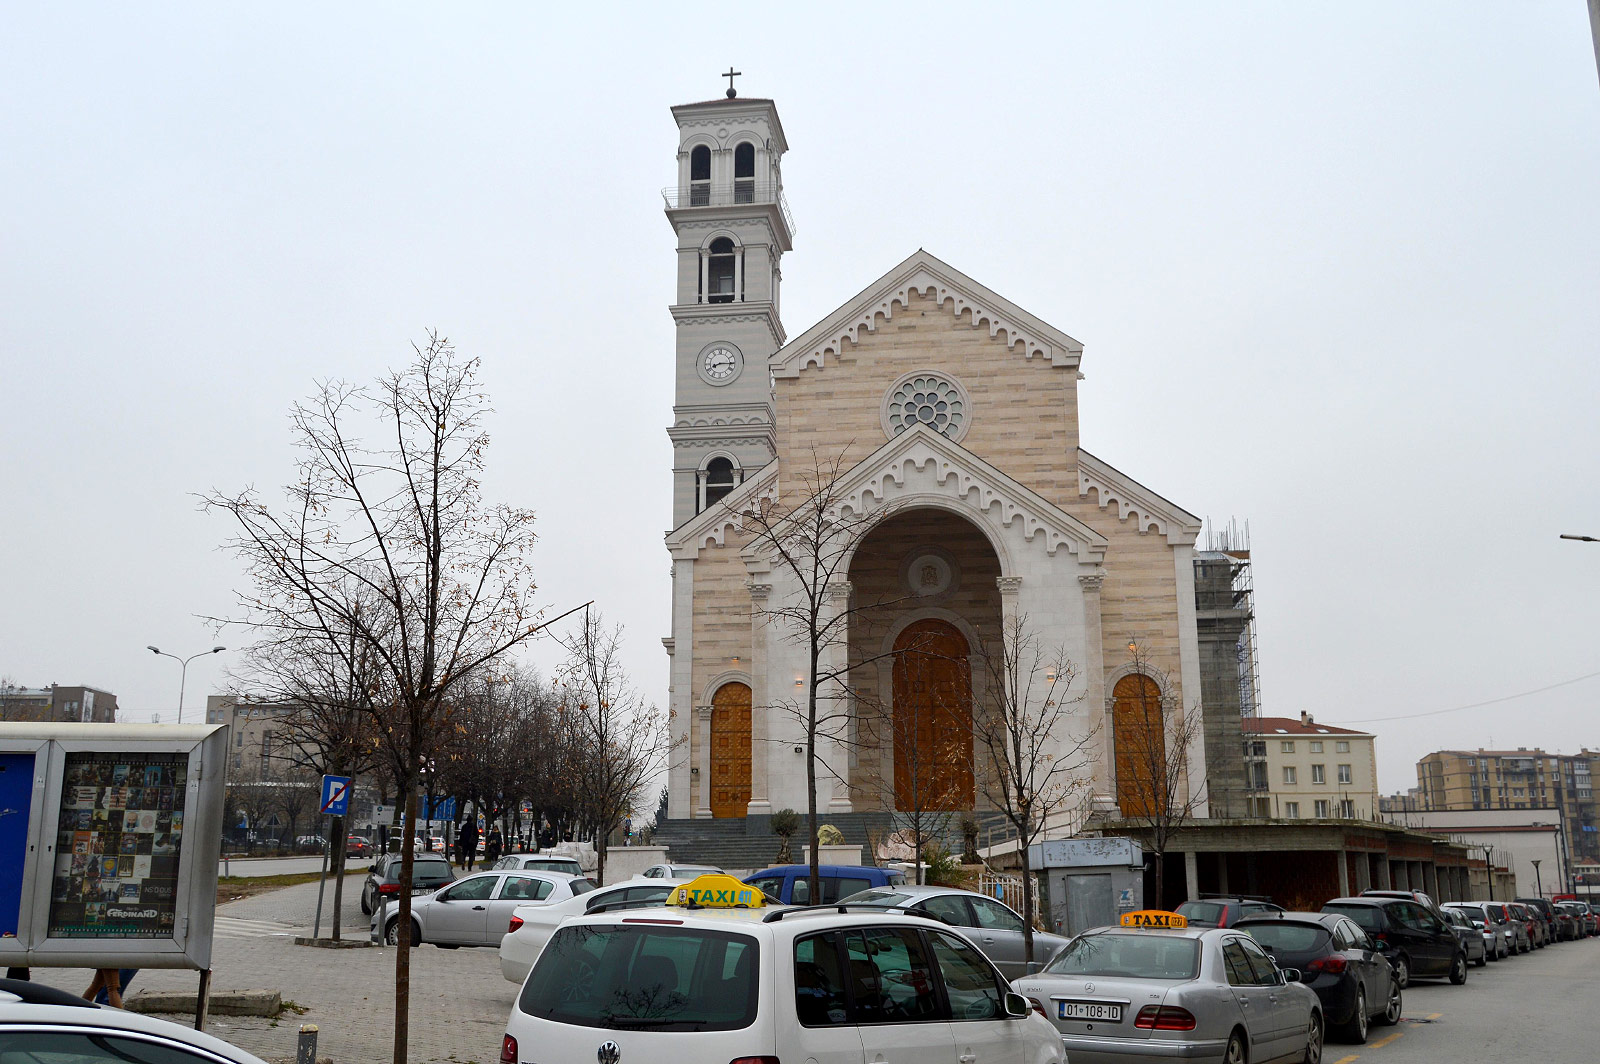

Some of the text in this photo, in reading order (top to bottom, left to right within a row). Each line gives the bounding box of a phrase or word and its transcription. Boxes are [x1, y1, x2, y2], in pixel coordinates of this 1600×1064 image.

[143, 886, 173, 894] NSDOUS
[691, 889, 752, 904] TAXI 411
[106, 908, 158, 918] FERDINAND
[1133, 914, 1170, 926] TAXI
